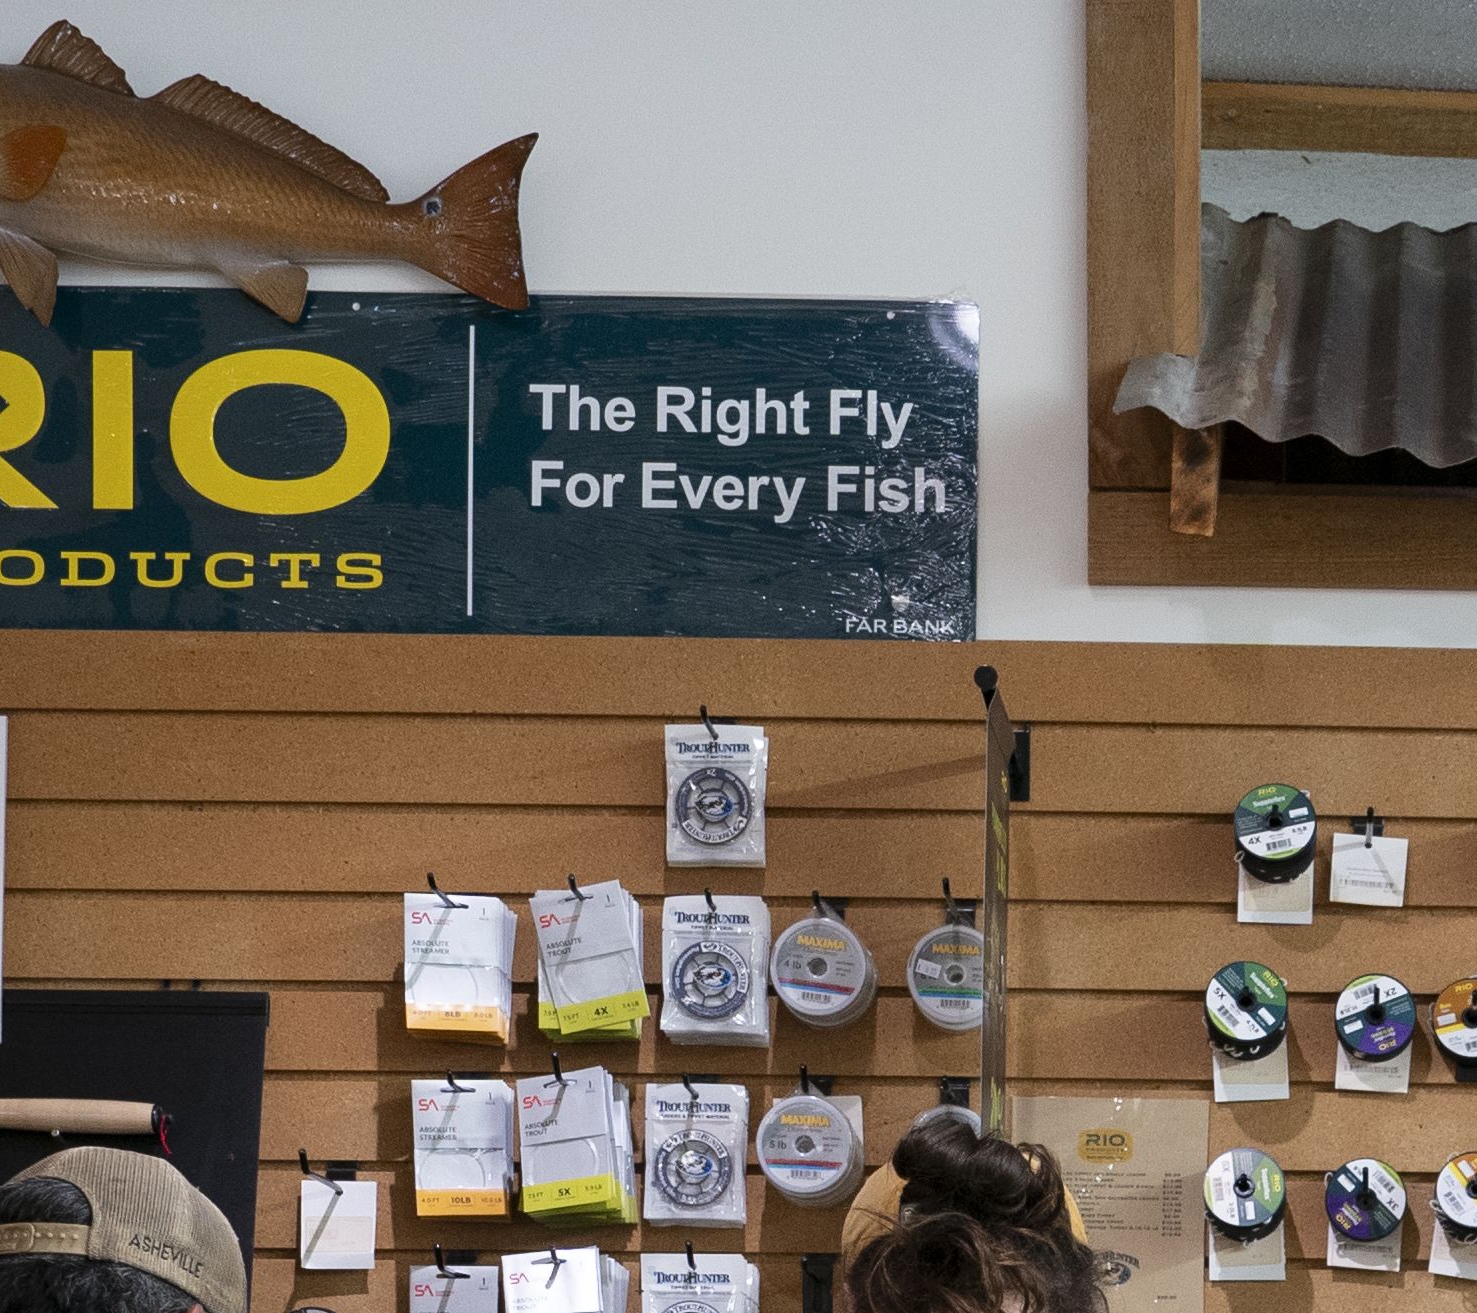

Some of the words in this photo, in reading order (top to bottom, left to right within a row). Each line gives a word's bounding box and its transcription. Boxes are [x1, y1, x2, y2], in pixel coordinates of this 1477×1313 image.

[529, 384, 636, 431] The
[657, 386, 810, 447] Right
[829, 389, 914, 449] Fly
[531, 460, 625, 508] For
[642, 462, 806, 524] Every
[827, 465, 946, 513] Fish
[845, 616, 887, 634] FAR
[893, 619, 954, 635] BANK
[412, 911, 432, 925] SA
[539, 914, 561, 928] SA
[797, 935, 845, 950] MAXIMA
[932, 944, 980, 956] MAXIMA
[419, 1098, 438, 1111] SA
[523, 1096, 542, 1109] SA
[780, 1114, 831, 1127] MAXIMA
[128, 1233, 204, 1279] ASHEVILLE
